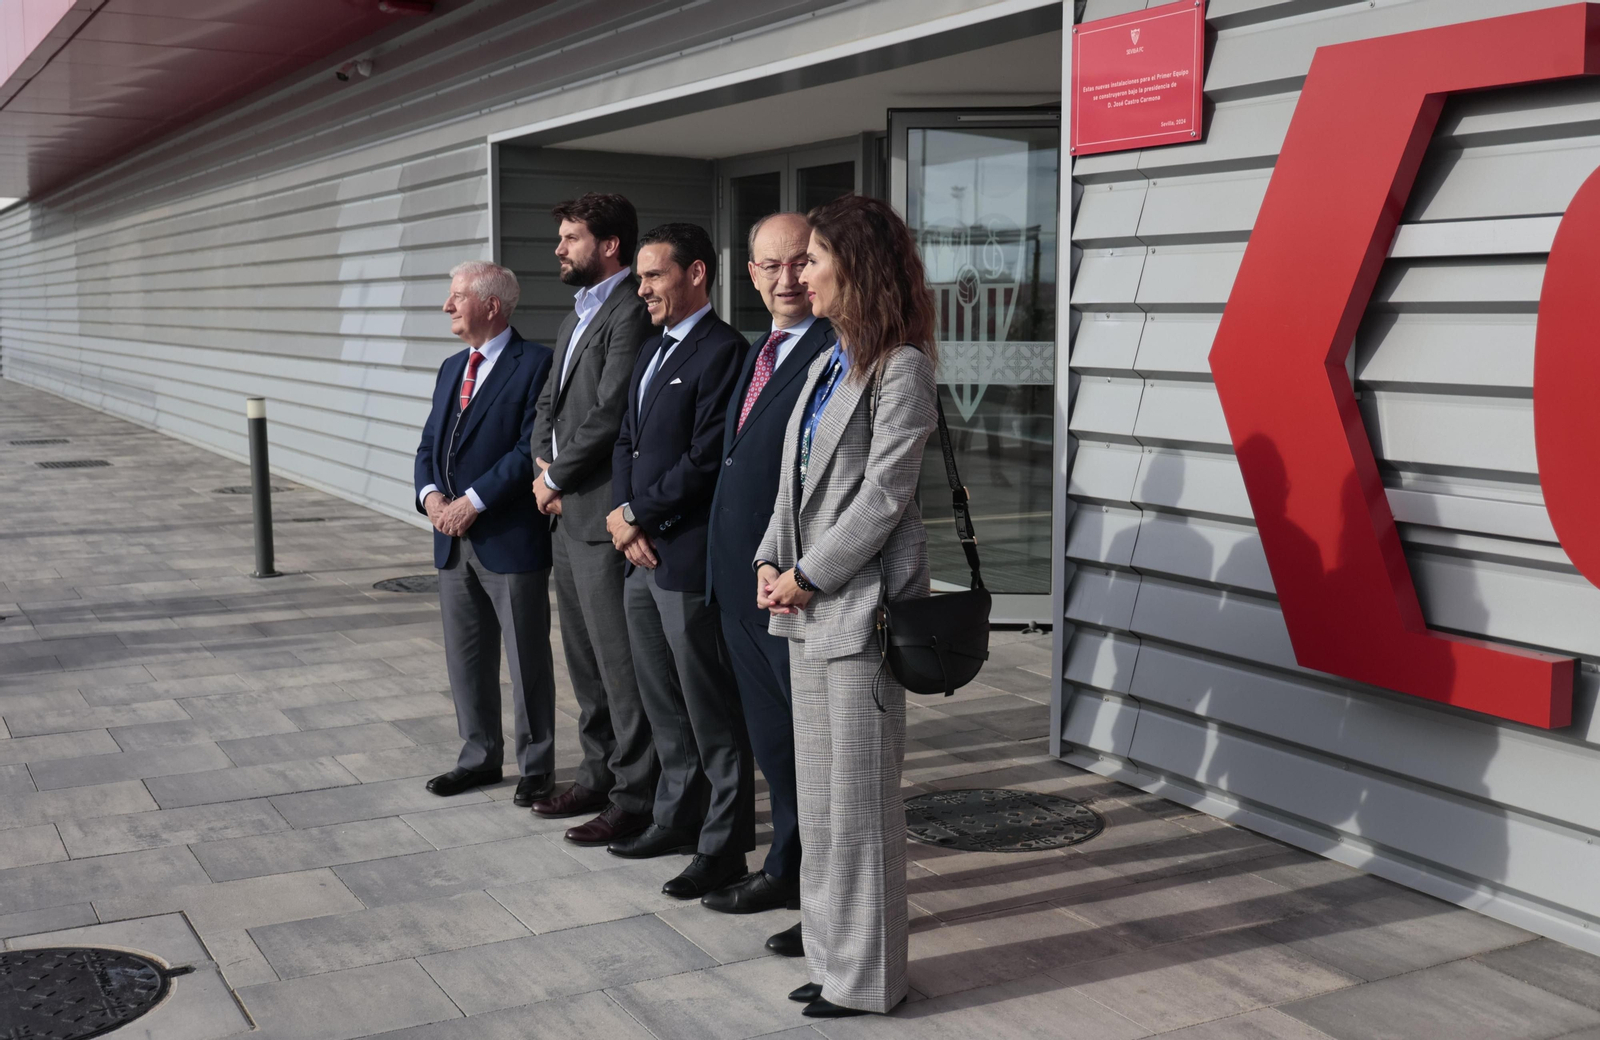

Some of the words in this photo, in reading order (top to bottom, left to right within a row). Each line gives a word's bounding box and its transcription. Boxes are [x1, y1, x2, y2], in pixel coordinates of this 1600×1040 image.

[1110, 79, 1139, 88] instalaciones
[1157, 72, 1172, 80] Primer
[1173, 69, 1189, 77] Equipo
[1099, 90, 1127, 98] construyeron
[1144, 83, 1170, 93] presidencia
[1124, 98, 1140, 106] Castro
[1140, 95, 1161, 103] Carmona
